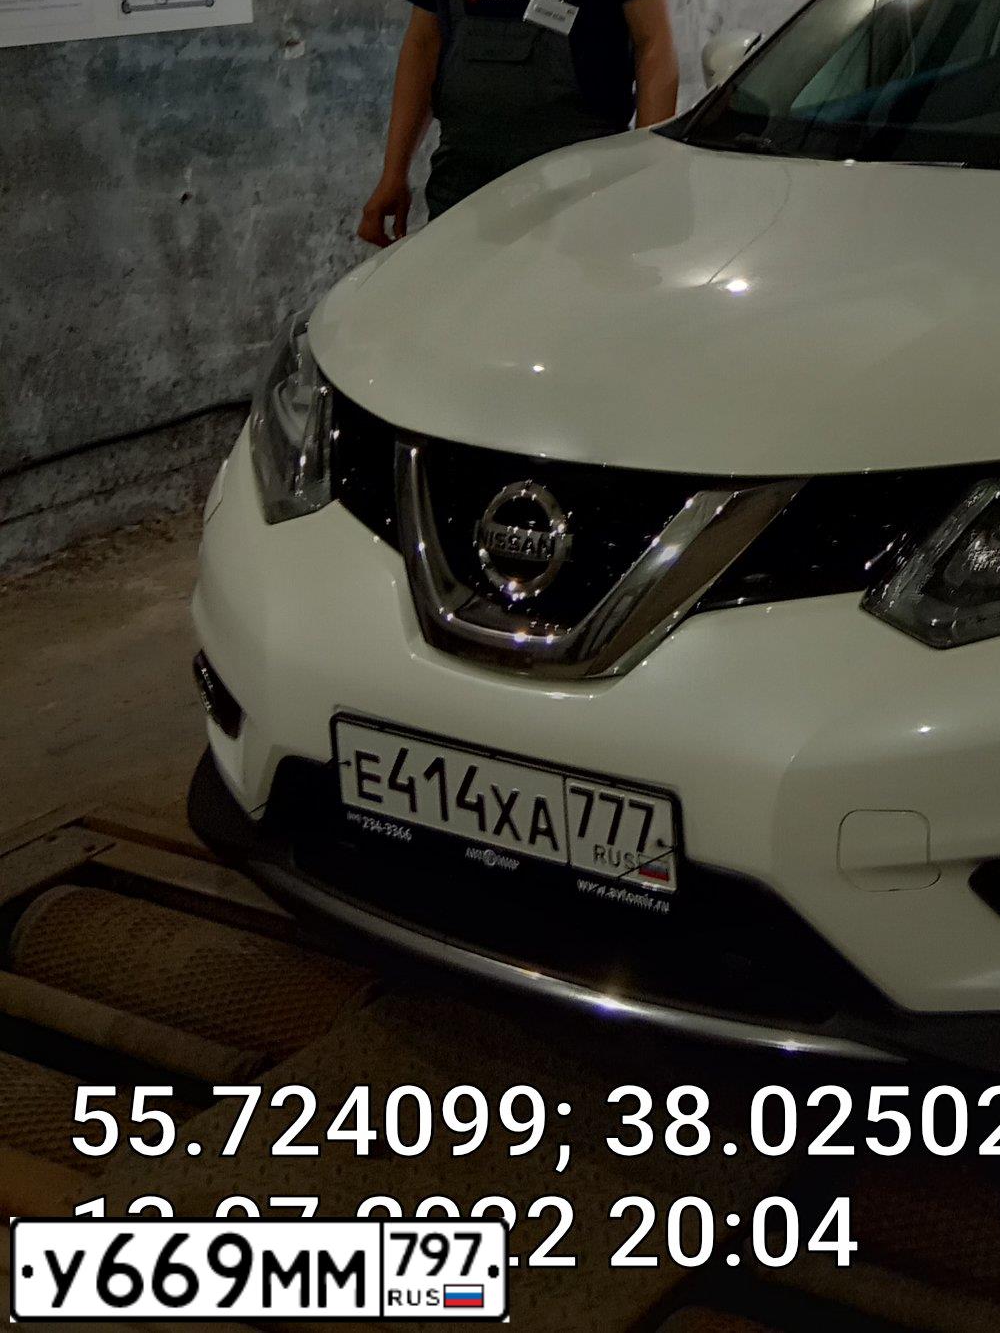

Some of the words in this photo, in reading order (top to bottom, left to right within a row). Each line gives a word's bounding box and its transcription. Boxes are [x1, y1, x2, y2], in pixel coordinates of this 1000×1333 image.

[478, 528, 557, 556] NISSAN
[570, 784, 655, 853] 777
[592, 843, 637, 869] RUS
